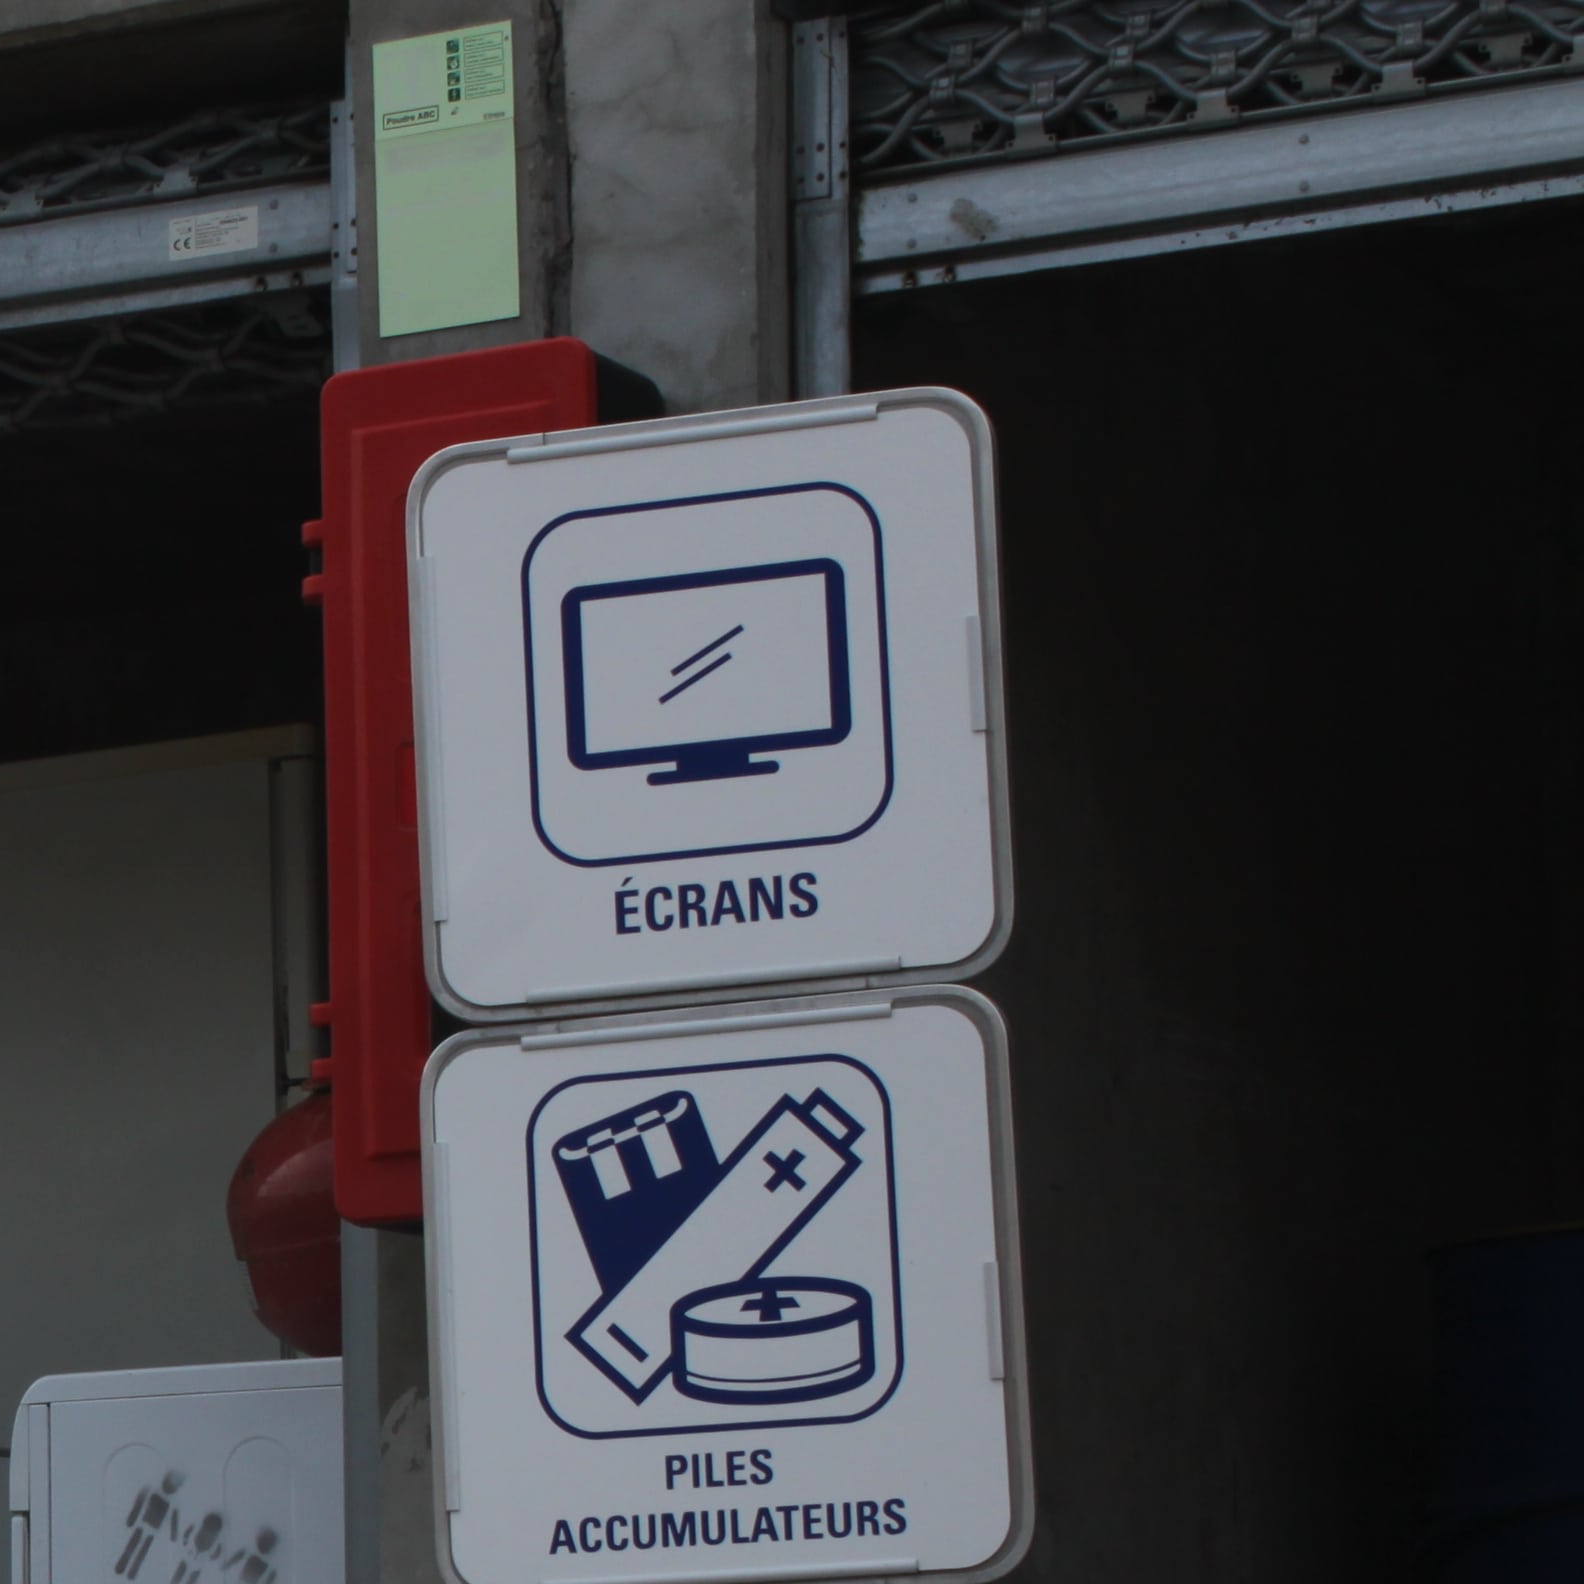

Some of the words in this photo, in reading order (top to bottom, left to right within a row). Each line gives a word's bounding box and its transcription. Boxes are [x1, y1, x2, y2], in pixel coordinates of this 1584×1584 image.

[417, 110, 436, 120] ABC
[615, 872, 819, 935] ÉCRANS
[664, 1449, 774, 1490] PILES
[549, 1498, 907, 1555] ACCUMULATEURS
